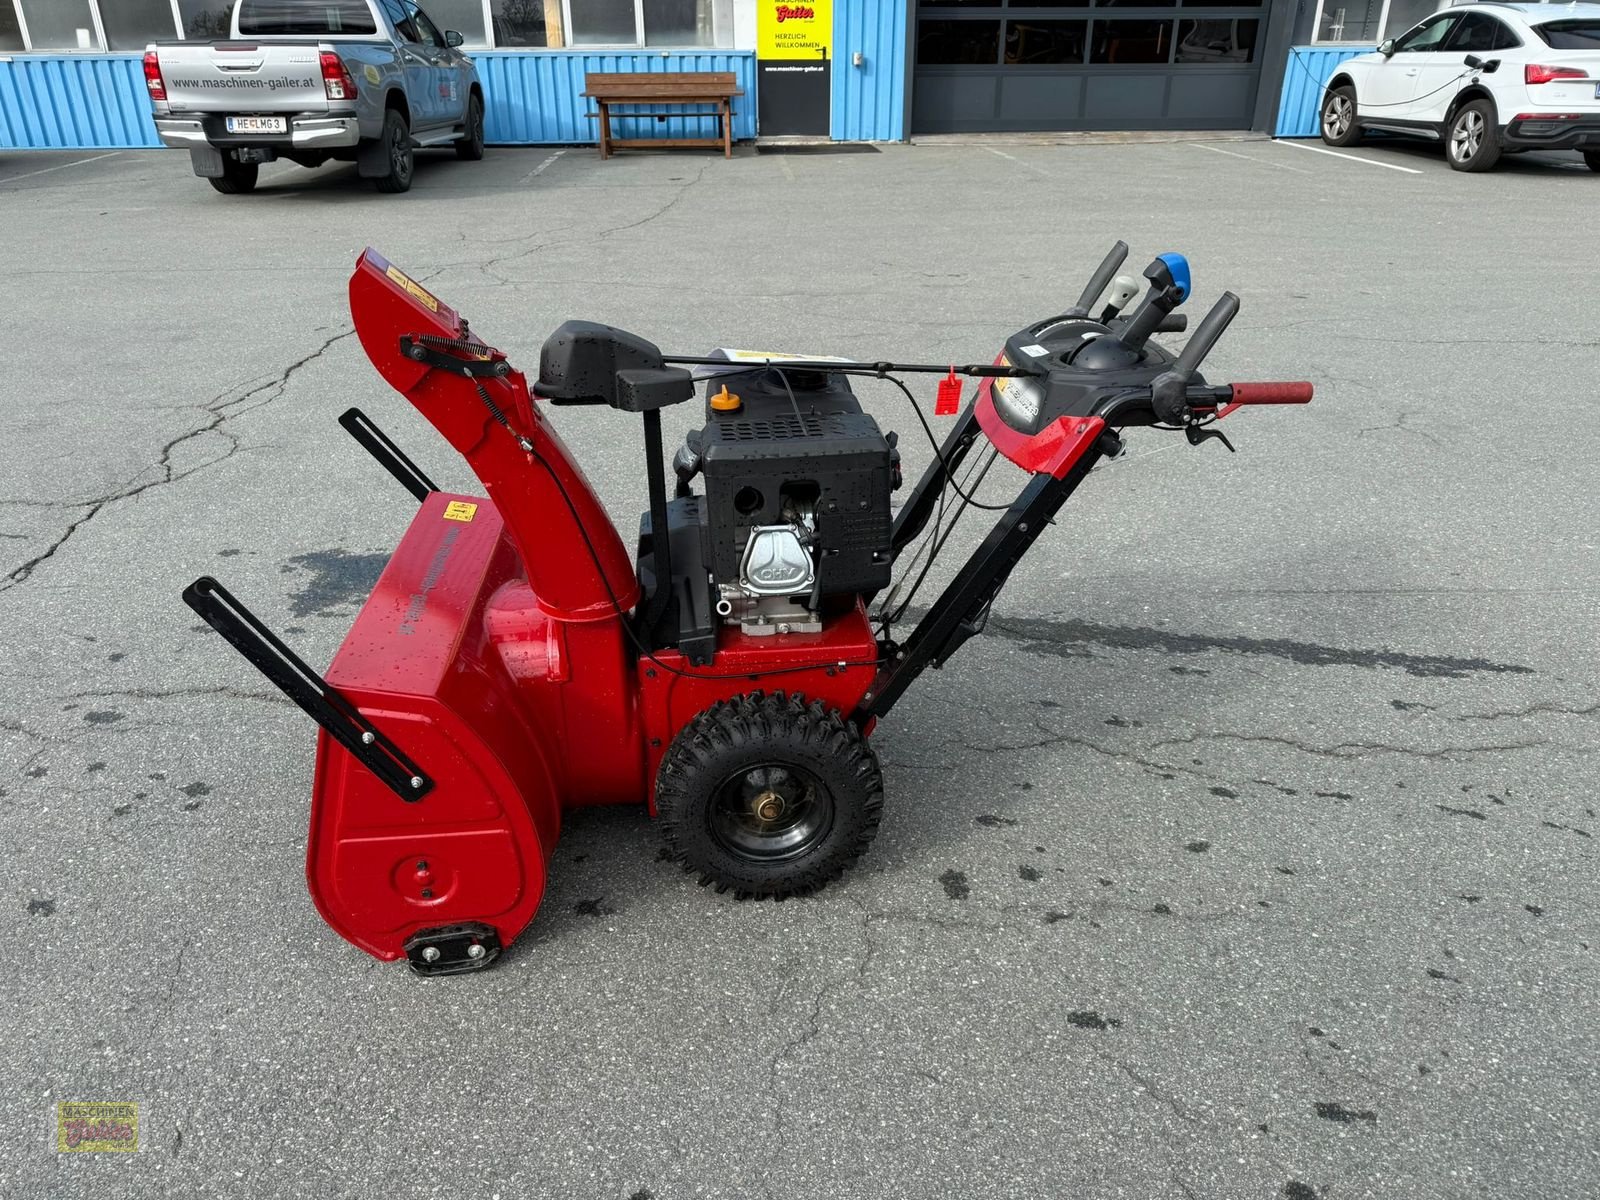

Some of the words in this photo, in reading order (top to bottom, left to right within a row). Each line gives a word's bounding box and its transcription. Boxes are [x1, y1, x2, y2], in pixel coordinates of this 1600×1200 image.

[776, 5, 815, 23] Gailer
[172, 76, 316, 91] www.maschinen-gailer.at
[237, 119, 250, 129] HE
[256, 119, 273, 129] LMG
[274, 119, 280, 129] 3
[760, 567, 797, 580] OHV
